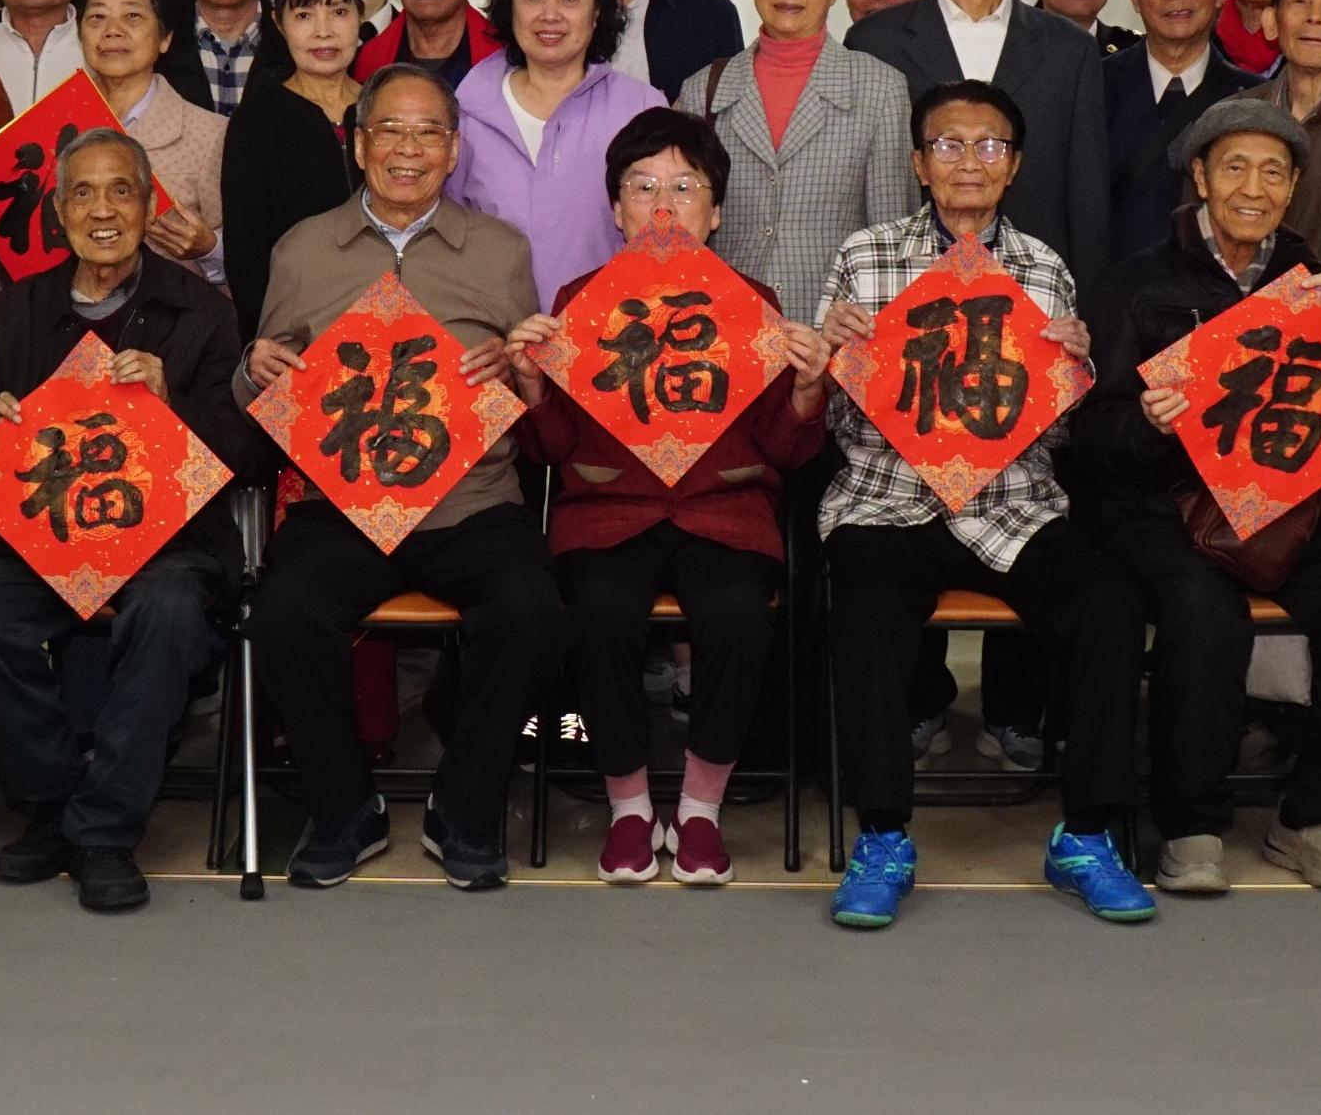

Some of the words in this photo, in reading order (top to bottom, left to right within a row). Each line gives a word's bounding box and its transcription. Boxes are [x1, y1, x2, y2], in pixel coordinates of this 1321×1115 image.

[319, 334, 451, 487] 福
[592, 290, 730, 424] 福
[895, 295, 1029, 440] 福
[14, 412, 145, 544] 福
